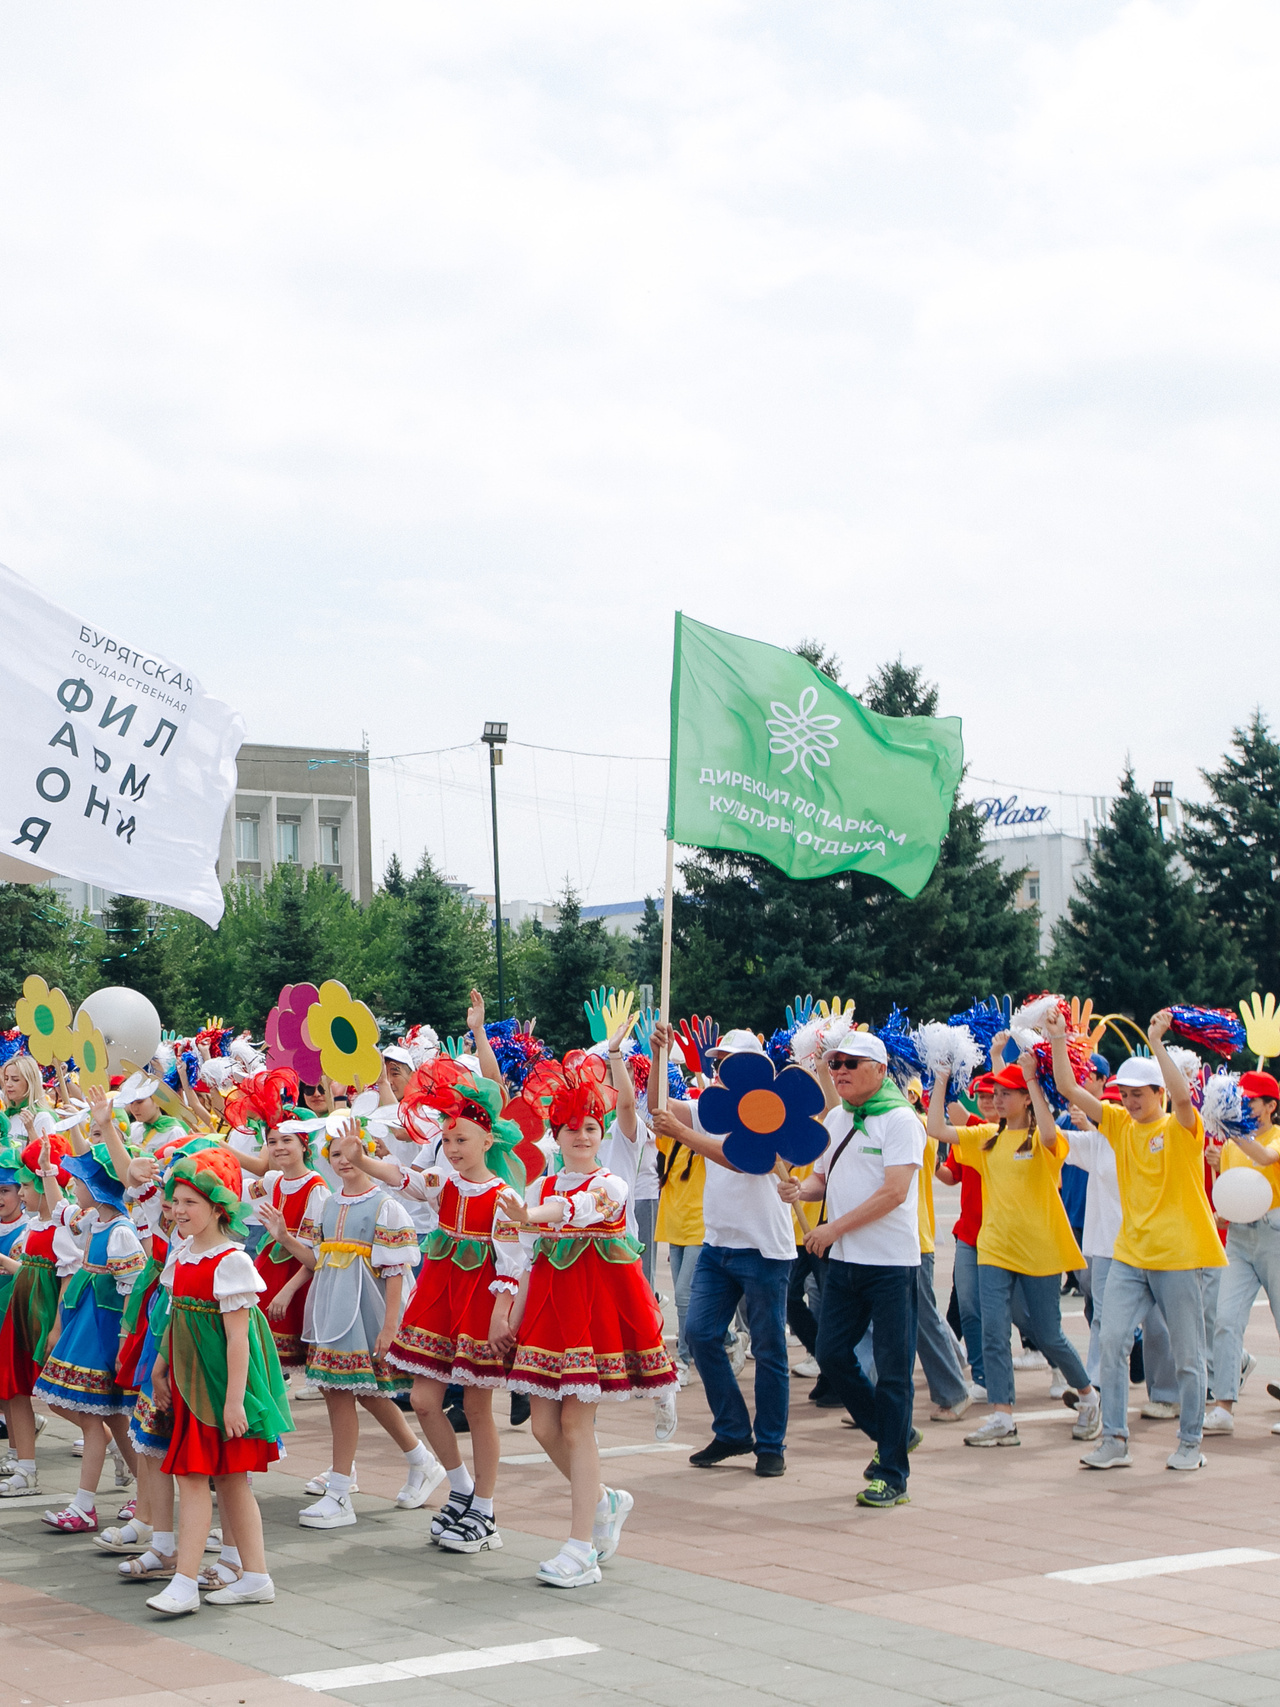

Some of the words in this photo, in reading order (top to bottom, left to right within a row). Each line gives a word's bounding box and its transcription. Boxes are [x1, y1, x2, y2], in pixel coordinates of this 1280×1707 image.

[71, 649, 188, 714] ГОСУДАРСТВЕННАЯ
[78, 625, 193, 695] БУРЯТСКАЯ
[709, 795, 793, 836] КУЛЬТУРЫ
[796, 831, 886, 856] ОТДЫХА
[792, 796, 816, 818] ПО
[815, 808, 907, 846] ПАРКАМ
[975, 795, 1051, 826] Plaza
